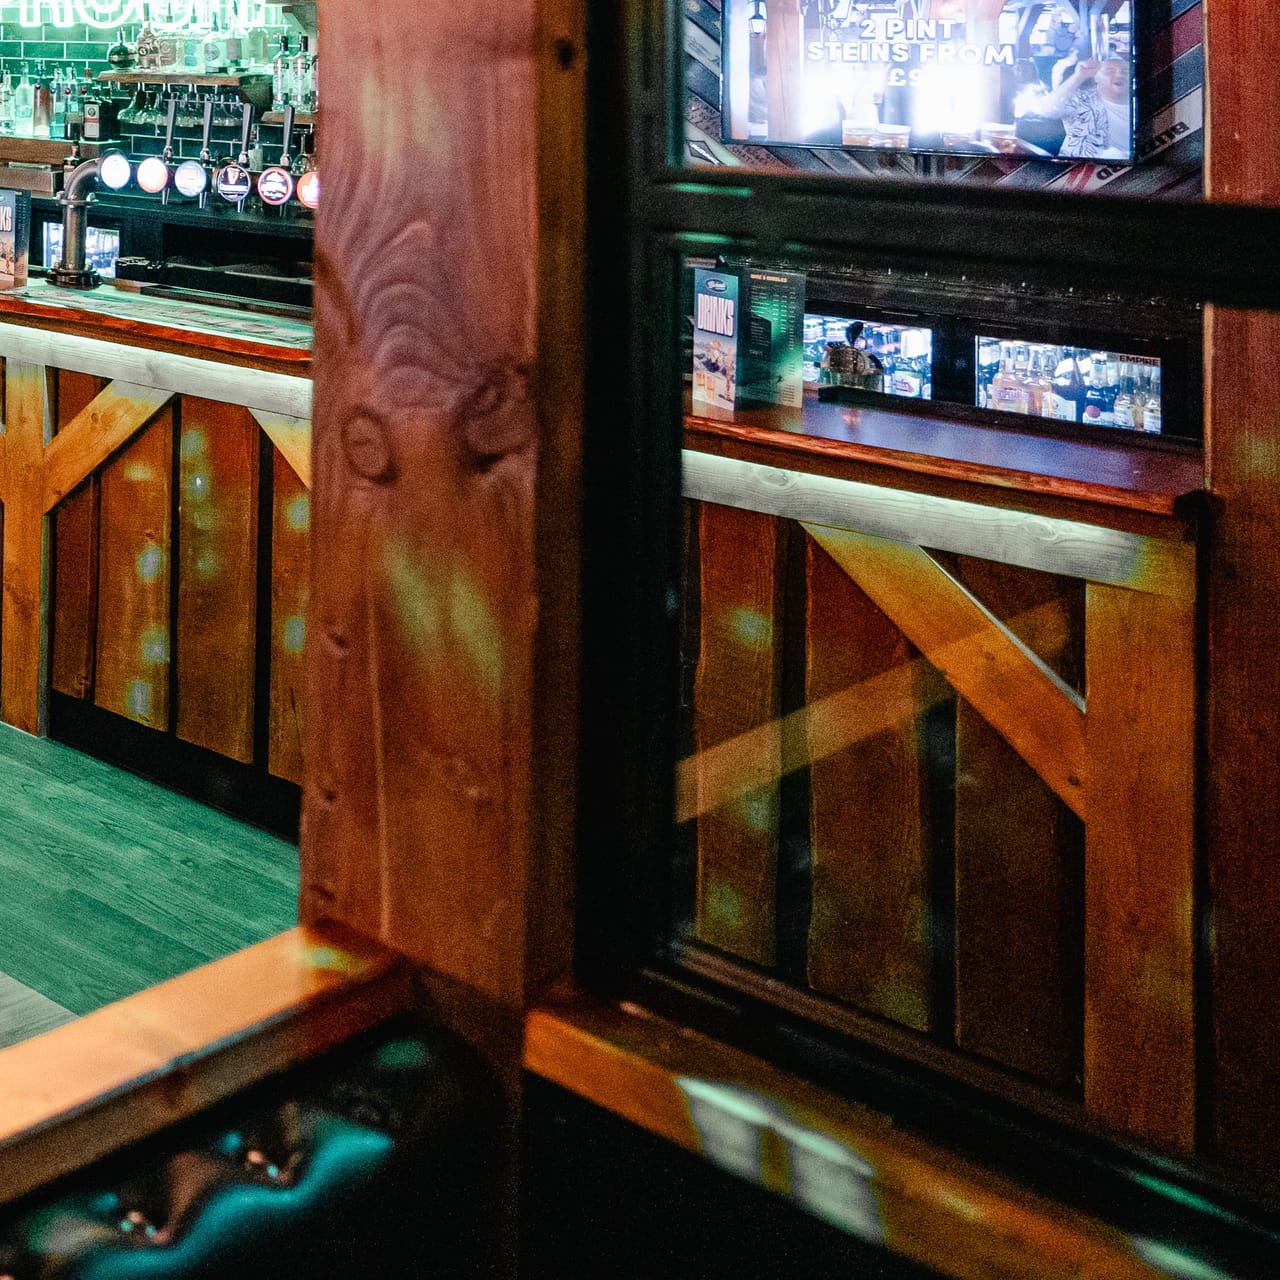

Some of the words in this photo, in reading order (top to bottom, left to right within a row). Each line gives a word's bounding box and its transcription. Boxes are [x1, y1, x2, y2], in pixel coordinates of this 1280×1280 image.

[859, 19, 877, 40] 2
[885, 19, 958, 40] PINT
[806, 41, 910, 63] STEINS
[919, 42, 1015, 65] FROM
[697, 293, 735, 337] DRINKS
[1119, 353, 1161, 367] EMPIRE
